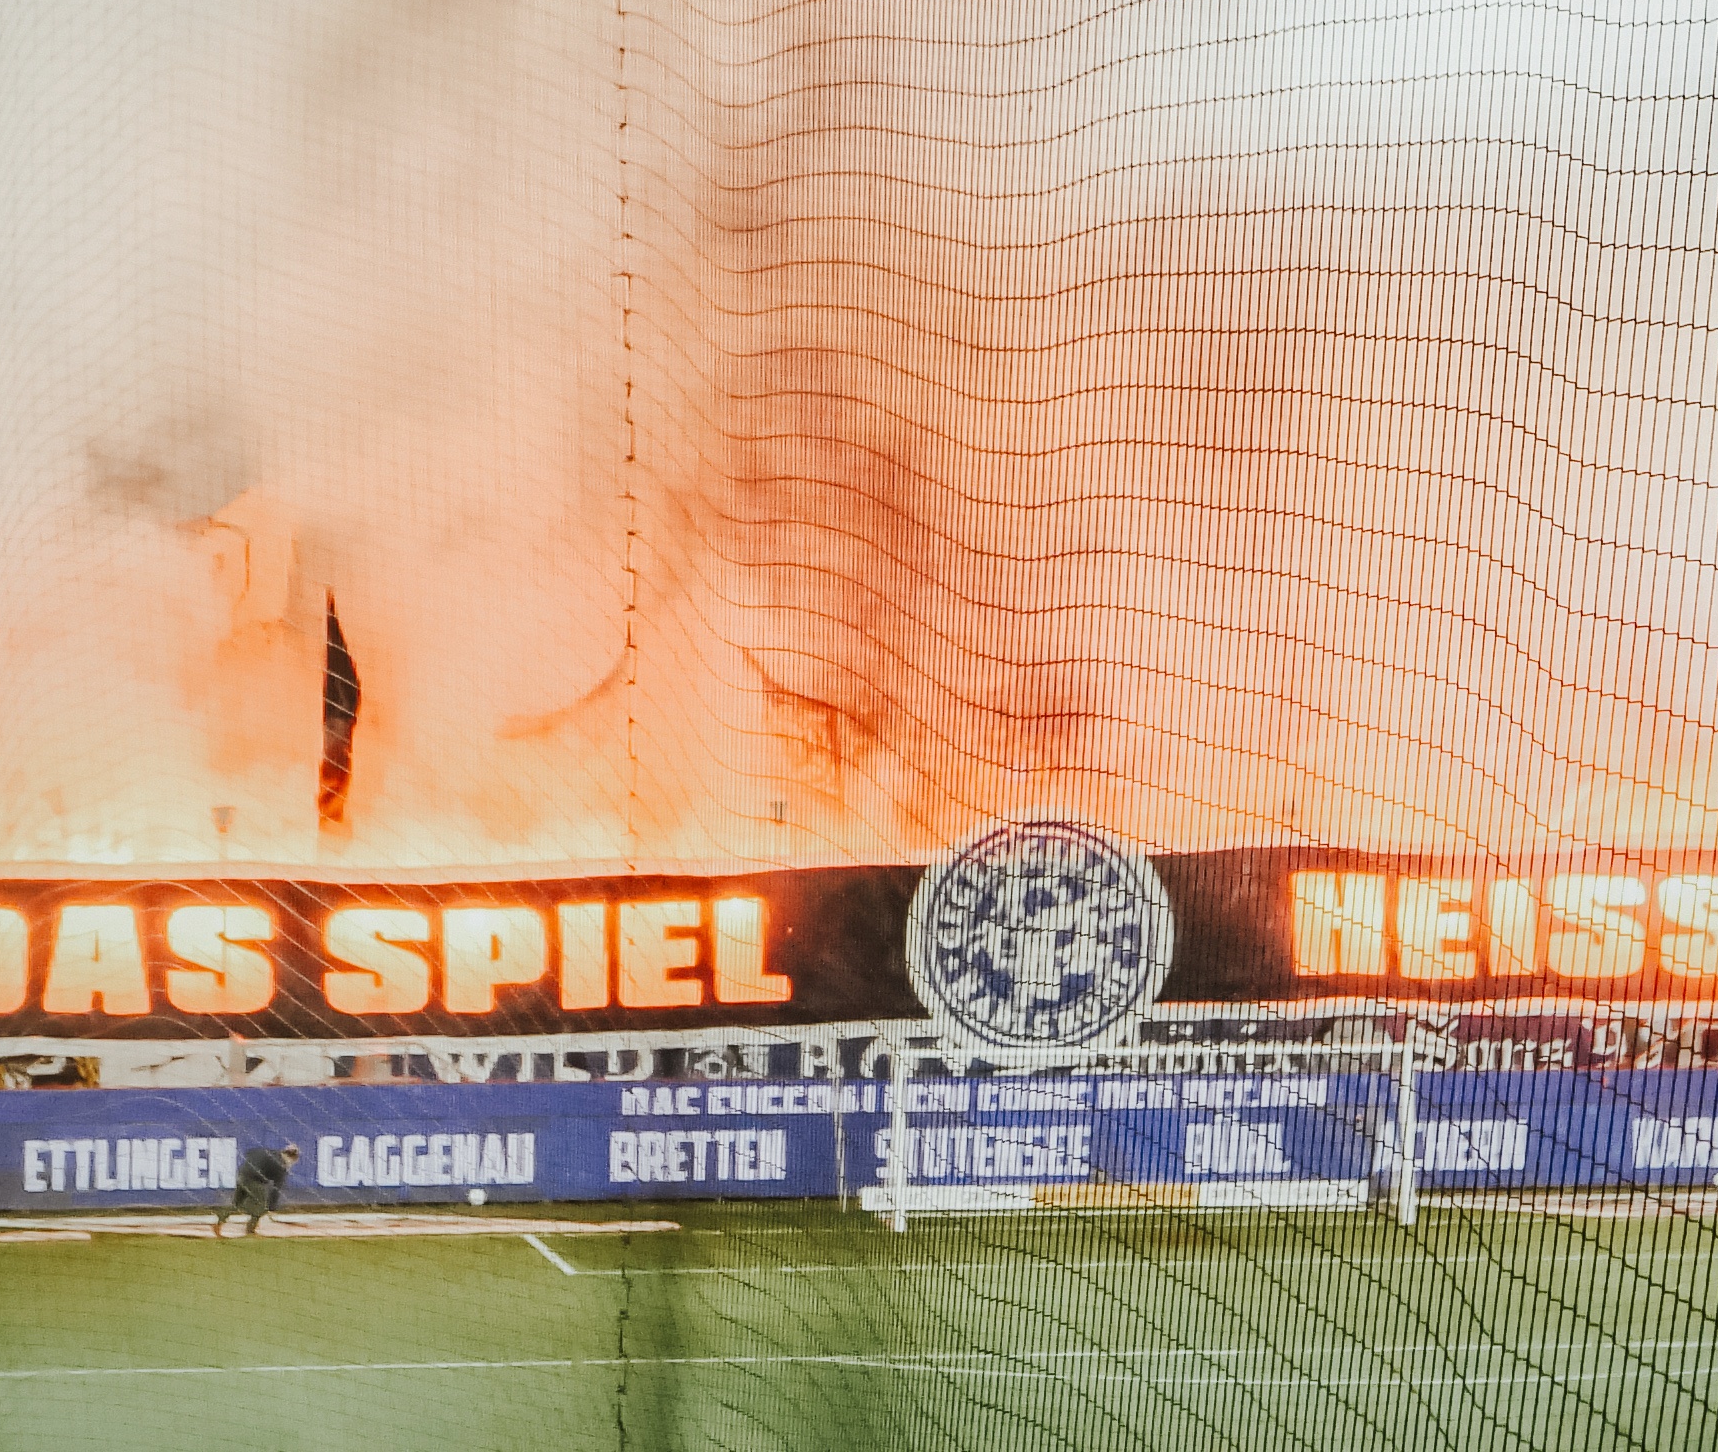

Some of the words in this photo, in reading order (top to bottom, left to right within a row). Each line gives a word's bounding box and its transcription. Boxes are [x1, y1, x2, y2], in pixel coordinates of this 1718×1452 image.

[324, 895, 791, 1013] SPIEL
[23, 1136, 237, 1193] ETTLINGEN
[317, 1132, 535, 1187] GAGGENAU
[608, 1128, 787, 1182] BRETTEN
